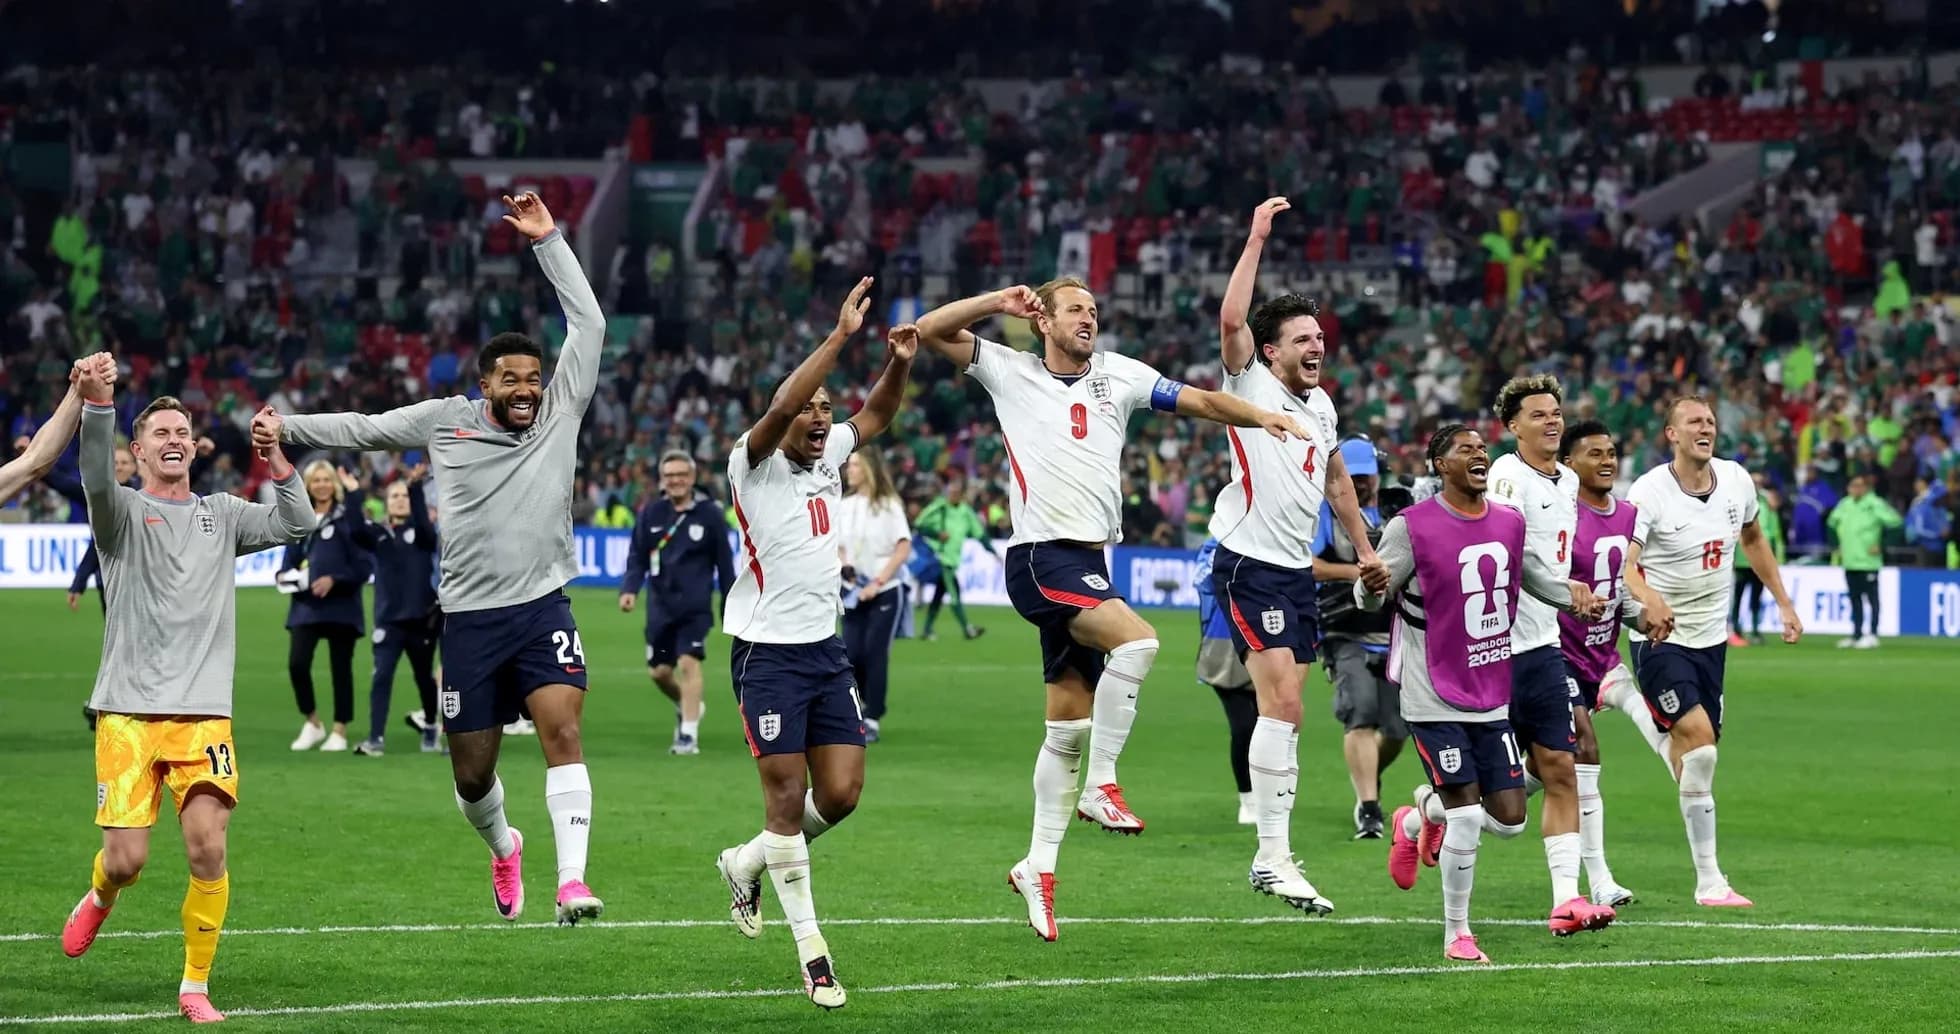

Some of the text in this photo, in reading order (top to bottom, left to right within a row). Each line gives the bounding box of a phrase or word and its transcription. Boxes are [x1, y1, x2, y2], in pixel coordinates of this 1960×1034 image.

[1070, 403, 1087, 440] 9
[1302, 445, 1315, 480] 4
[807, 497, 830, 537] 10
[1557, 530, 1567, 563] 3
[1702, 540, 1724, 570] 15
[1481, 616, 1499, 630] FIFA
[1815, 592, 1853, 621] FIF
[552, 630, 585, 664] 24
[1467, 640, 1496, 653] WORLD
[1468, 646, 1511, 668] 2026
[206, 743, 233, 779] 13
